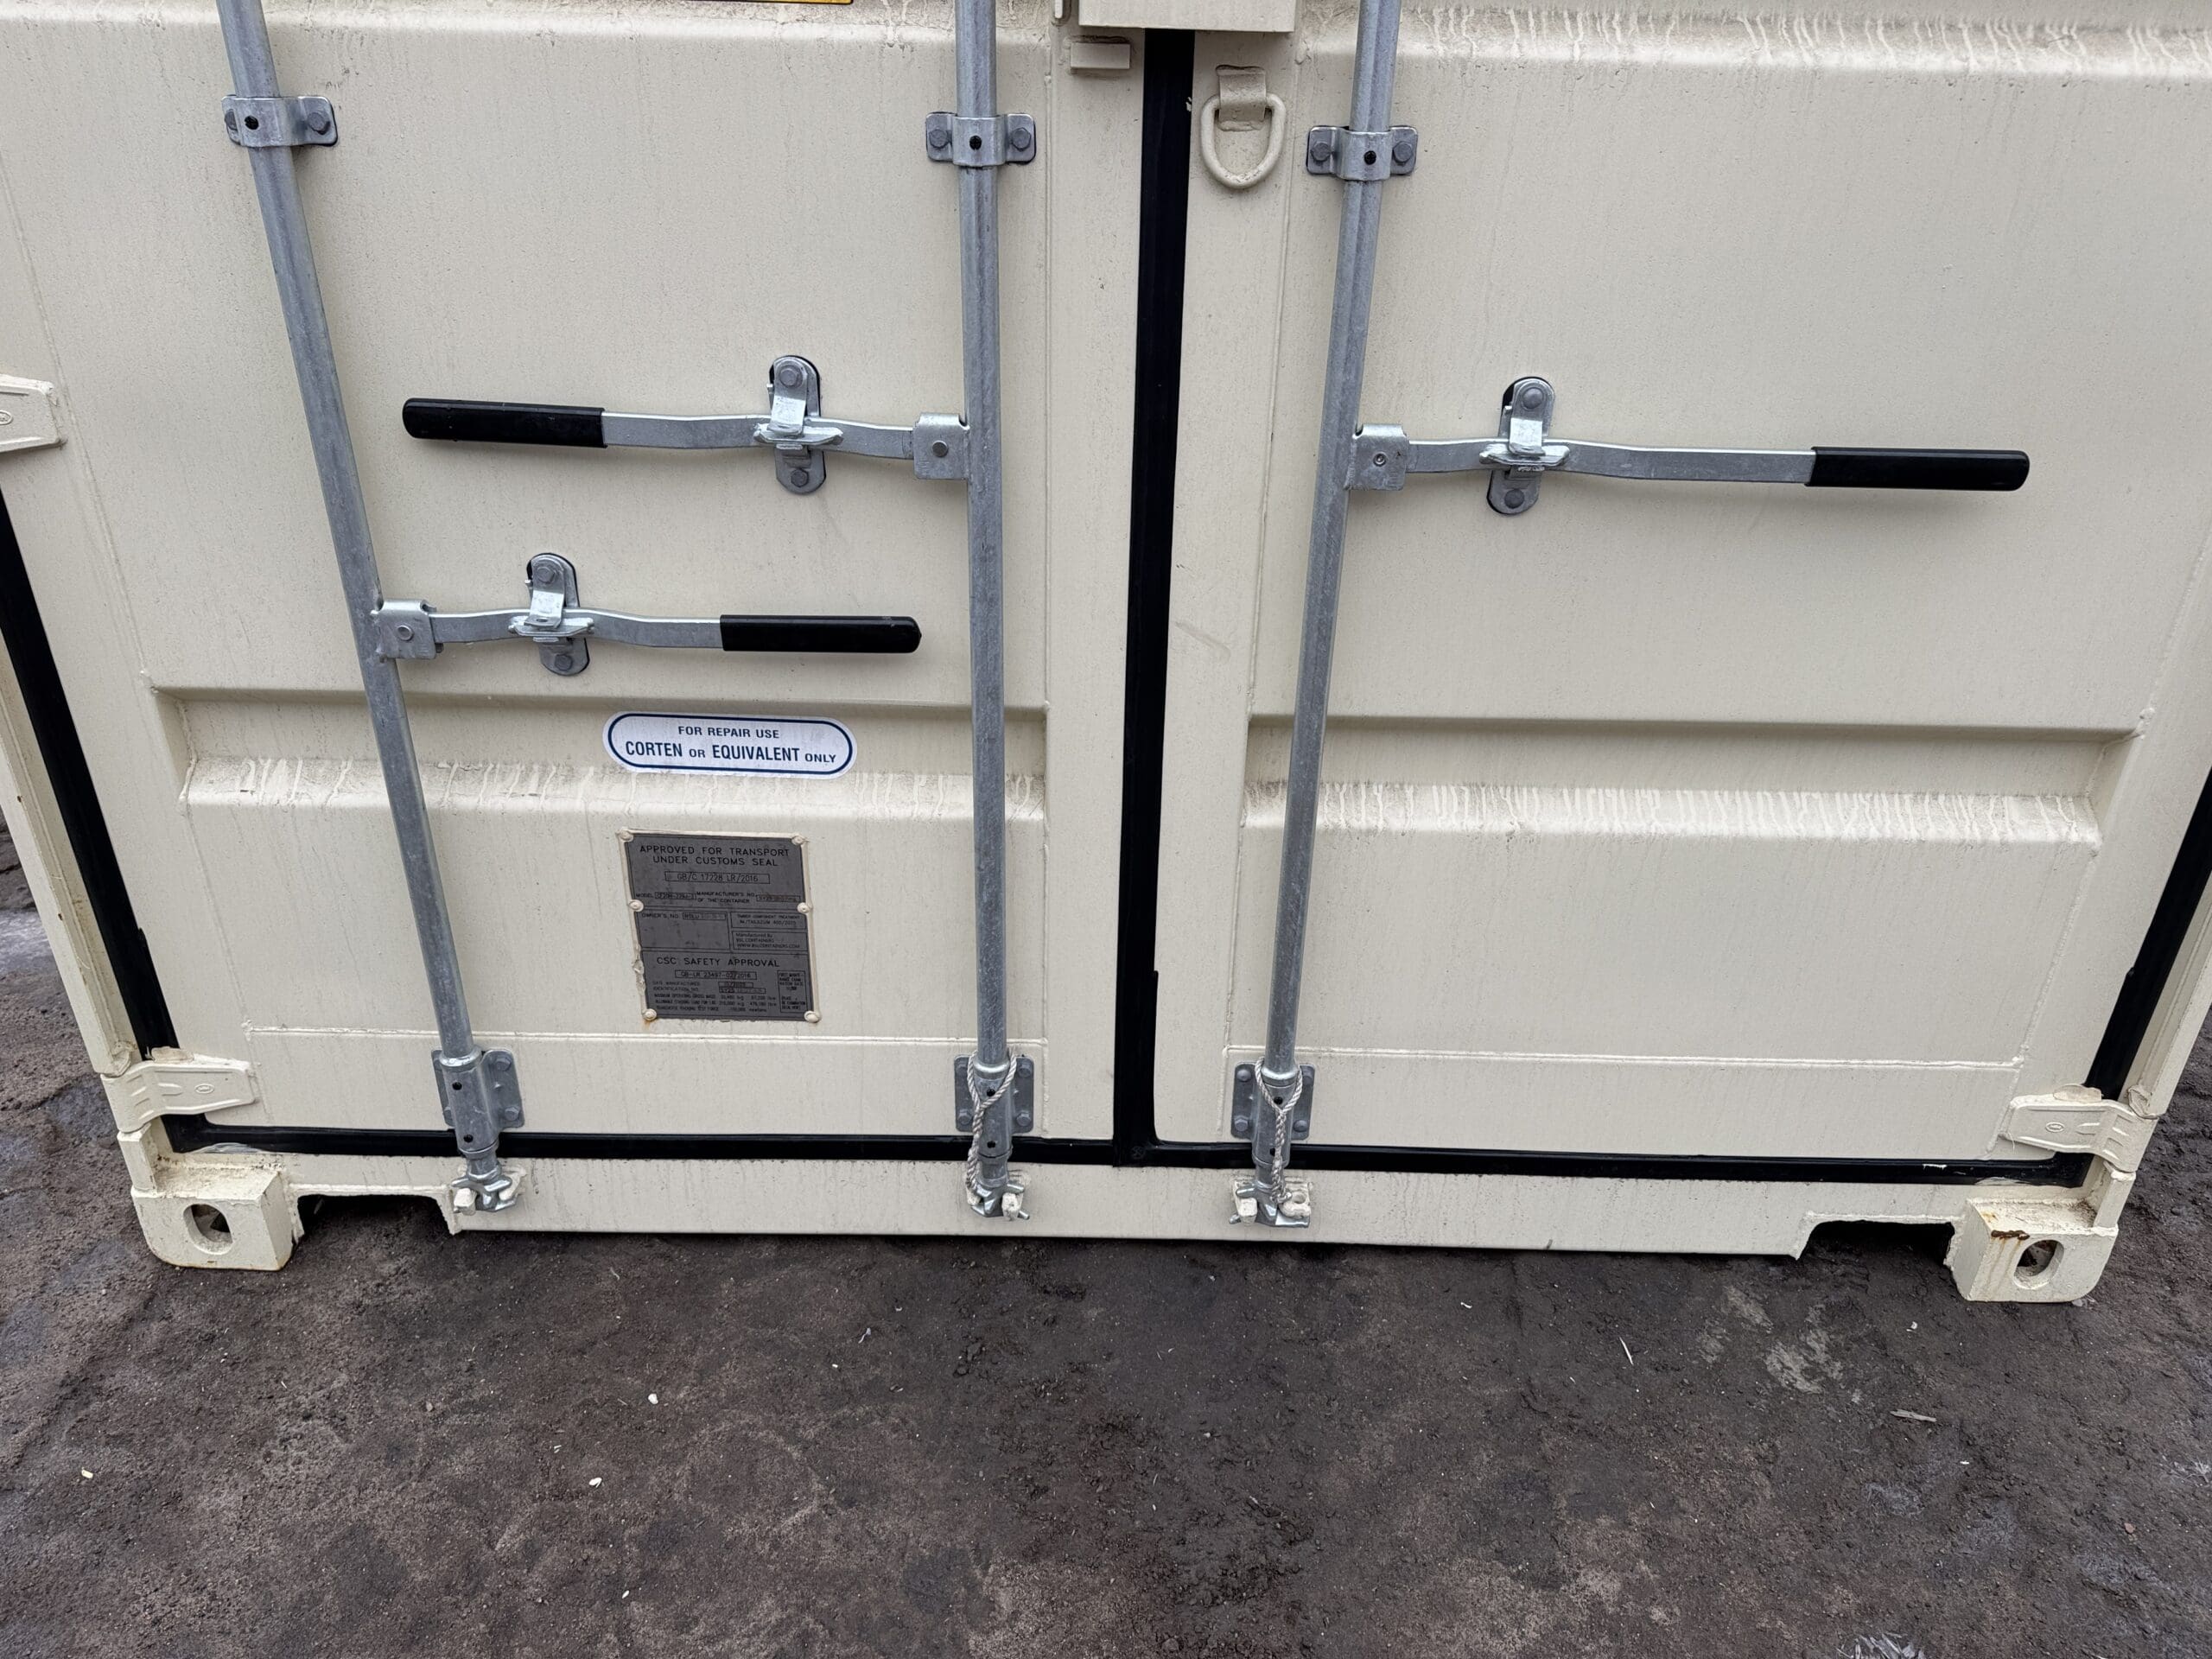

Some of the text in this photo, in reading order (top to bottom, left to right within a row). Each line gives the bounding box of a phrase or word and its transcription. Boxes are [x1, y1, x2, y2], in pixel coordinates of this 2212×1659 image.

[678, 726, 780, 739] FOR REPAIR USE
[626, 741, 836, 763] CORTEN OR EQUIVALENT ONLY
[639, 845, 790, 857] APPROVED FOR TRANSPORT
[652, 855, 779, 867] UNDER CUSTOMS SEAL
[677, 873, 697, 881] GB/C
[701, 873, 723, 882] 17228
[657, 957, 780, 968] CSC SAFETY APPROVAL
